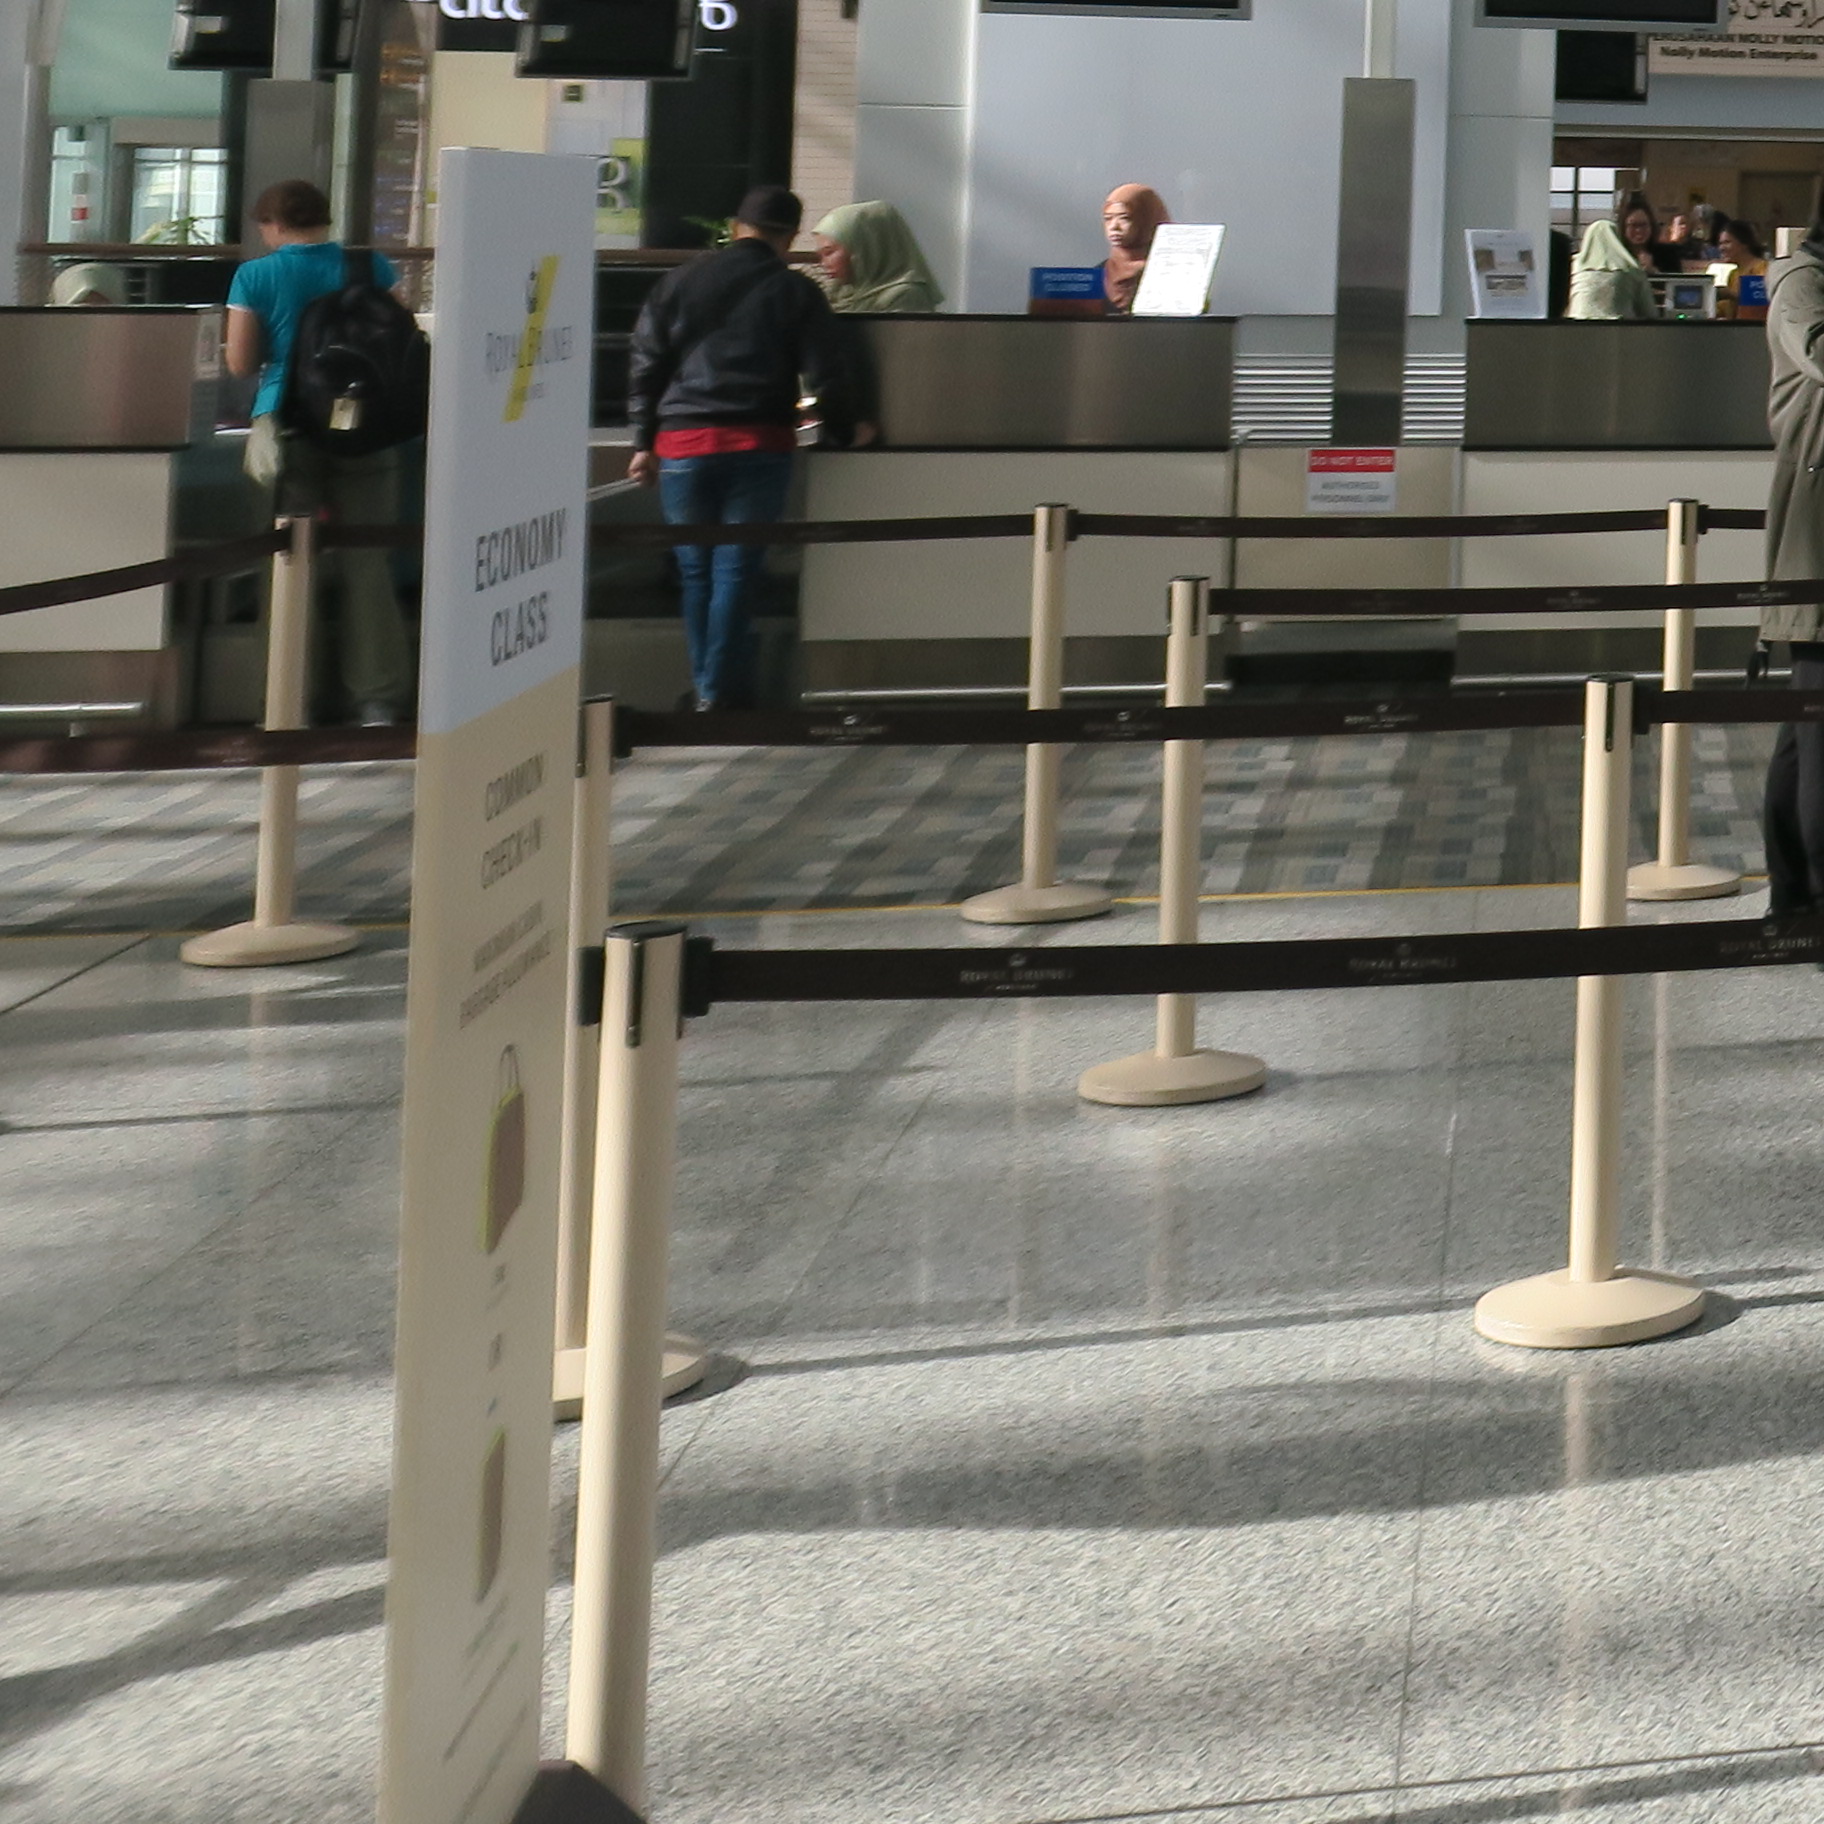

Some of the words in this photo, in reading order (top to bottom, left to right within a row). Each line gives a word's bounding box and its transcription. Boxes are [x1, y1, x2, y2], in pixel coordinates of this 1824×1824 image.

[1661, 47, 1694, 60] Nolly
[1698, 47, 1747, 58] Motion
[1750, 49, 1818, 62] Enterprise
[1739, 34, 1779, 44] NOLLY
[475, 507, 567, 593] ECONOMY
[490, 591, 547, 666] CLASS
